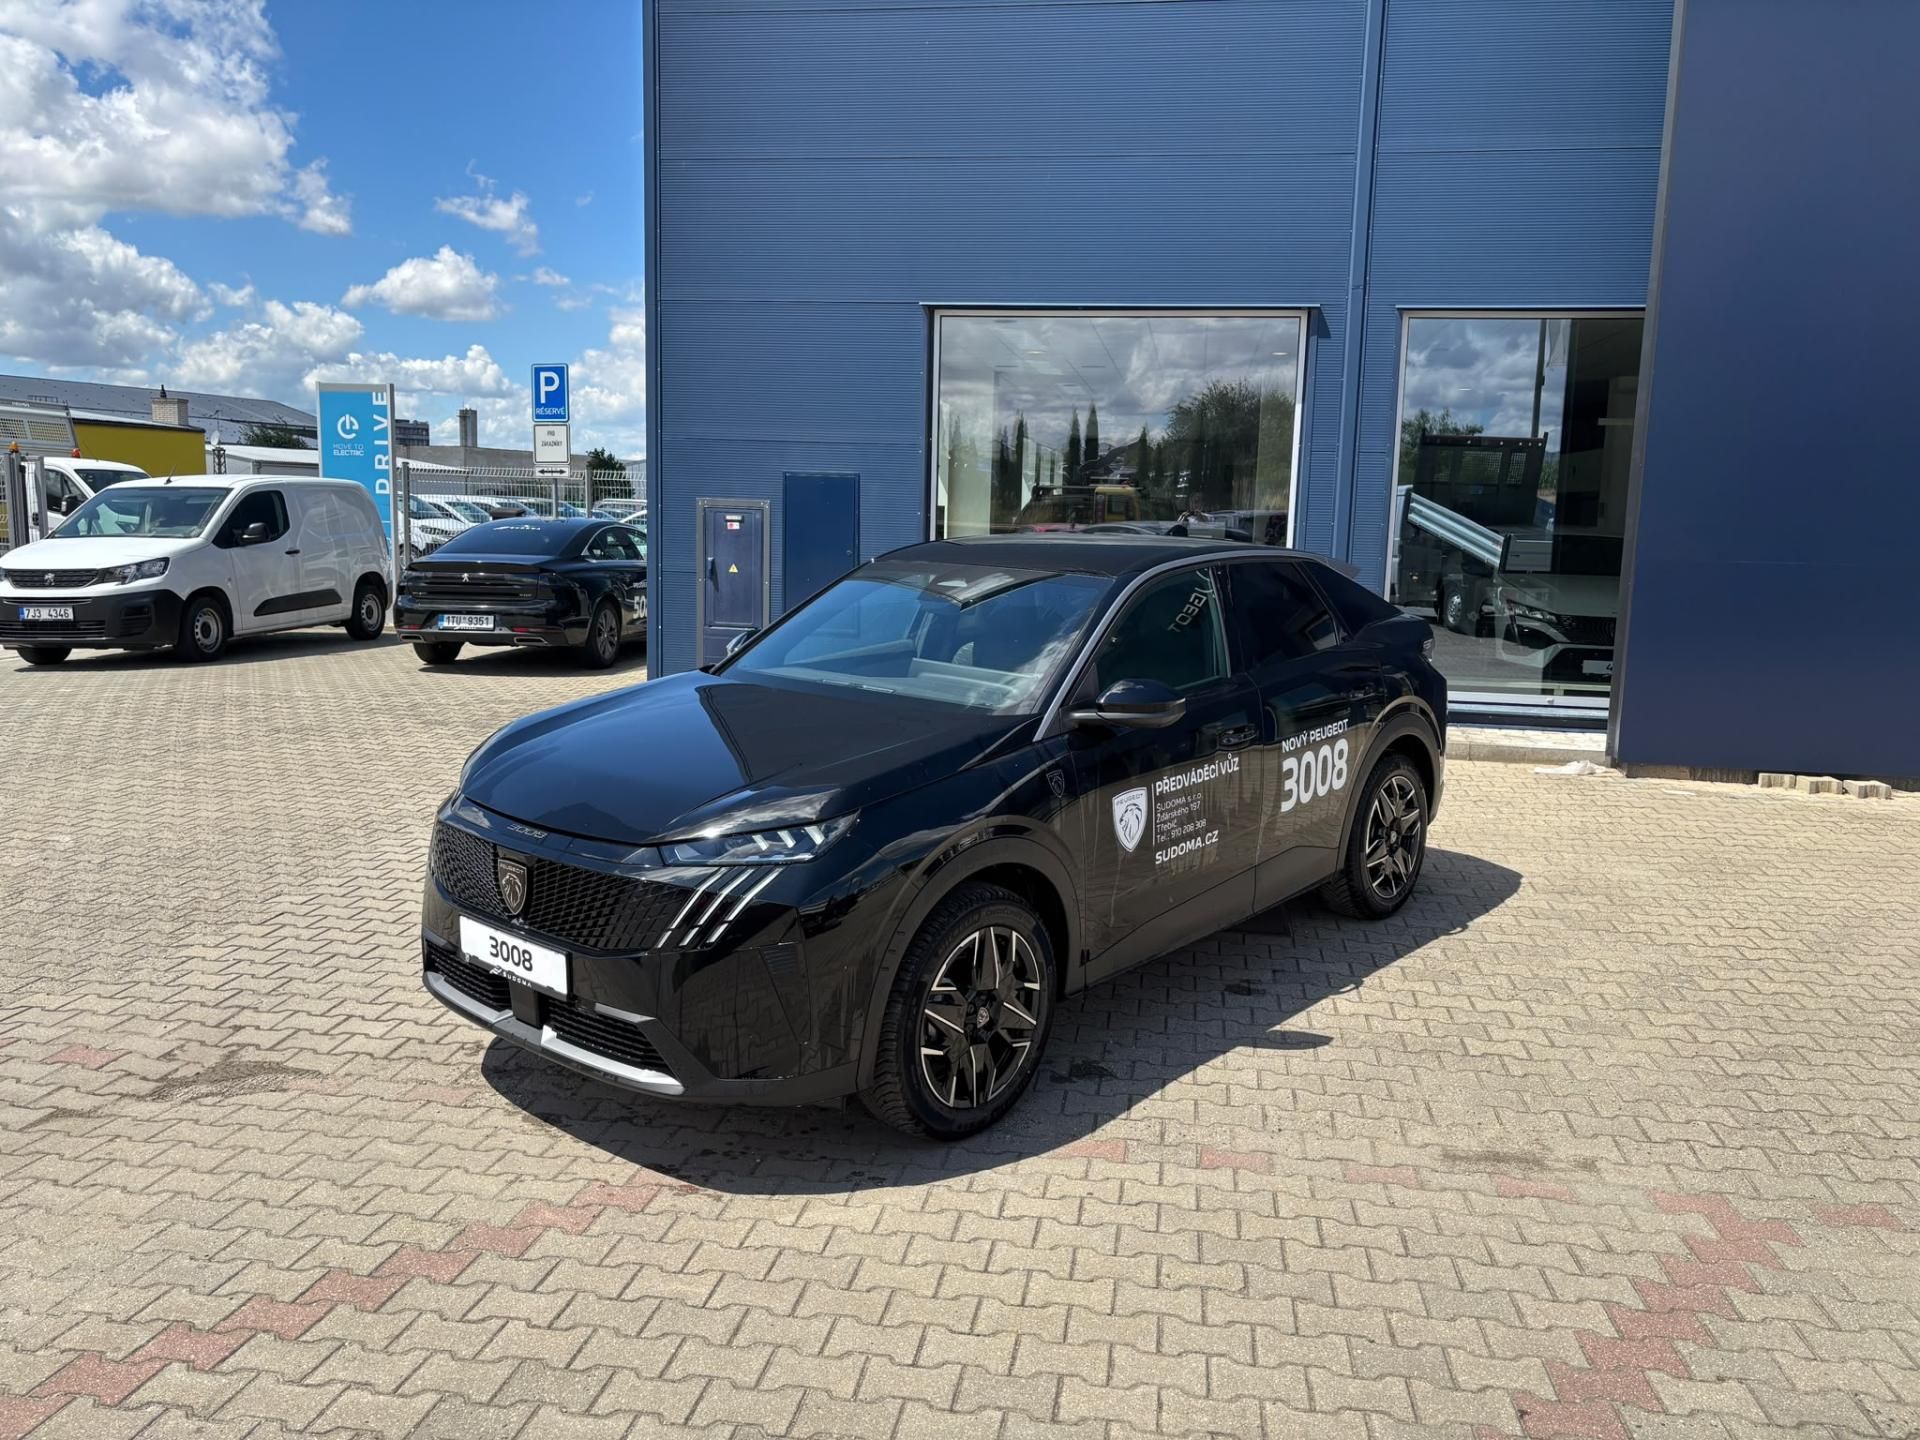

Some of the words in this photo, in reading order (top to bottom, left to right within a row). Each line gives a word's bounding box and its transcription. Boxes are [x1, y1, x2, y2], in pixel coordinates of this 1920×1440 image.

[539, 371, 560, 404] P
[372, 391, 390, 495] DRIVE
[25, 608, 42, 619] 7J3
[47, 608, 70, 619] 4346
[632, 594, 648, 620] 50
[1281, 730, 1308, 753] NOVÝ
[1309, 718, 1349, 744] PEUGEOT
[1156, 760, 1219, 796] PŘEDVÁDĚCÍ
[1220, 753, 1240, 776] VŮZ
[1280, 738, 1349, 813] 3008
[1156, 796, 1186, 813] SUDOMA
[1155, 830, 1219, 865] SUDOMA.CZ
[488, 935, 533, 972] 3008
